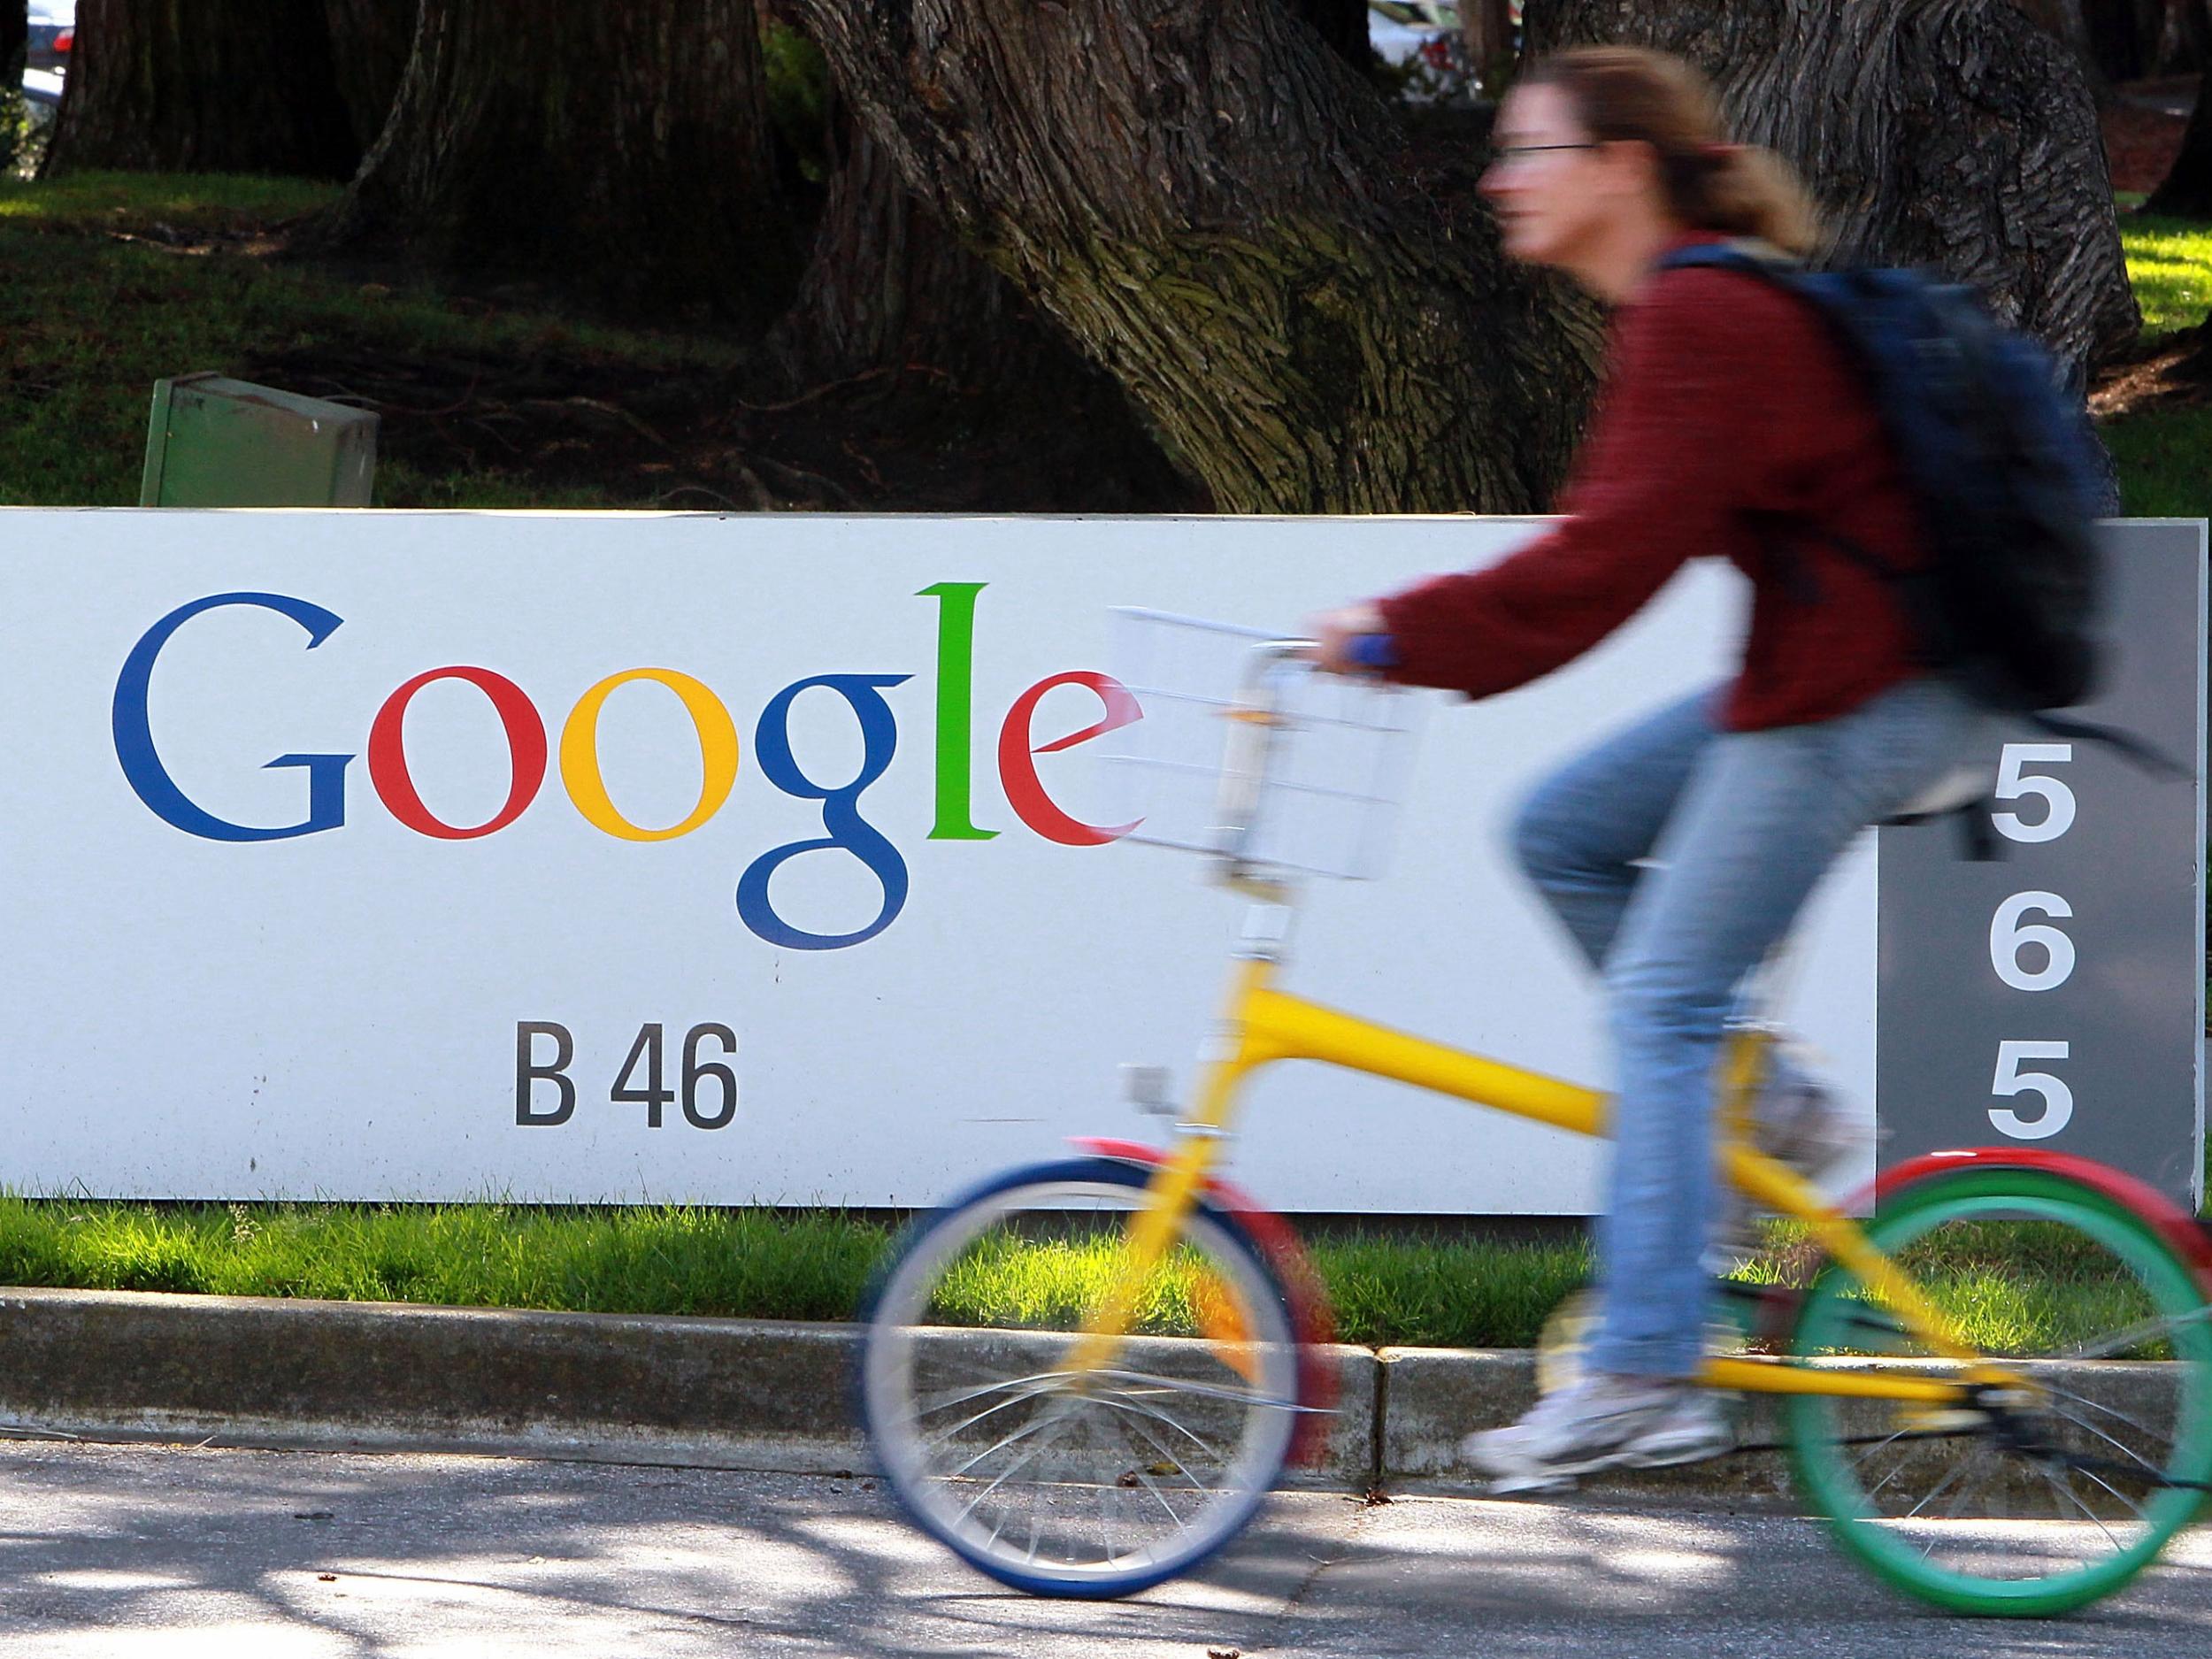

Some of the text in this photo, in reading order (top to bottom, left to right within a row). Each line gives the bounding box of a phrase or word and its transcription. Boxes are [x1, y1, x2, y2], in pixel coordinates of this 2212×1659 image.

[113, 582, 1146, 949] Google
[517, 1022, 738, 1130] B 46
